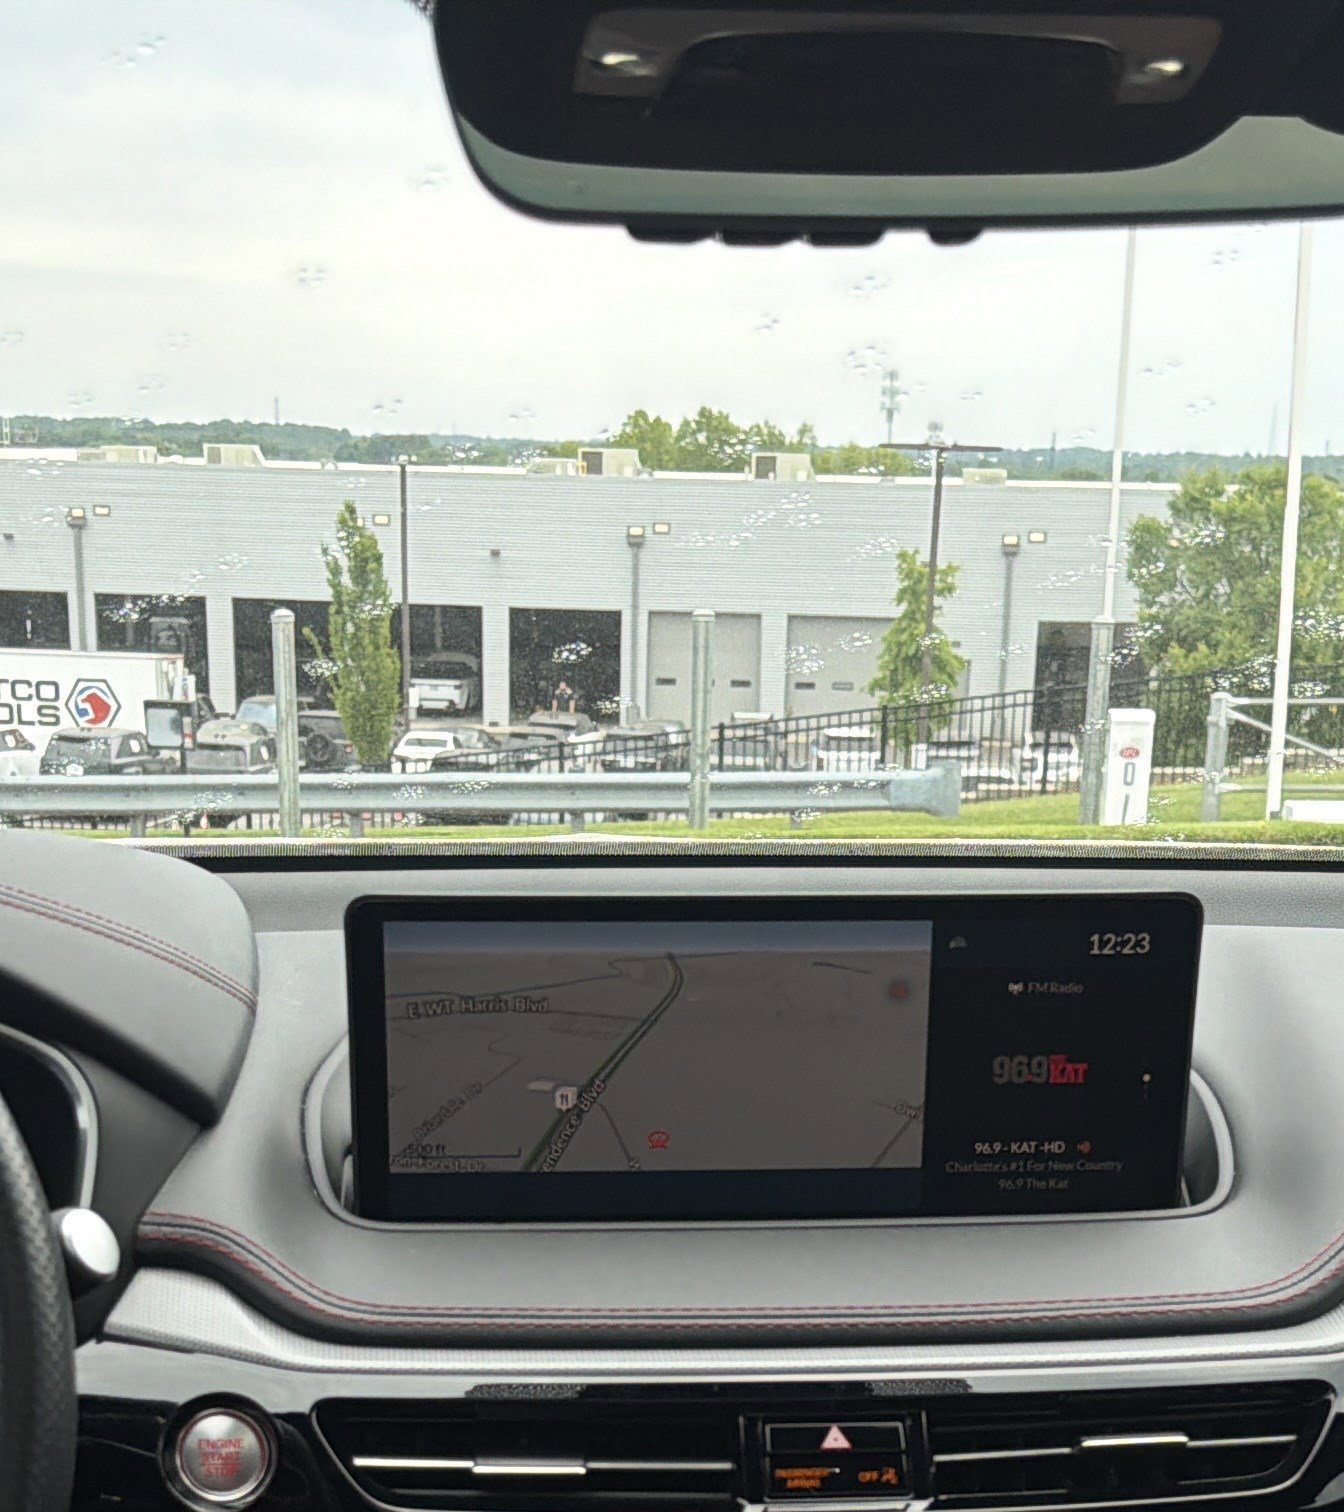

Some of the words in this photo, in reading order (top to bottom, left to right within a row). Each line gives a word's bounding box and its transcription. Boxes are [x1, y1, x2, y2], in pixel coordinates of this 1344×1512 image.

[1088, 932, 1151, 955] 12:23
[1027, 982, 1048, 994] FM
[1049, 981, 1084, 994] Radio
[408, 1003, 420, 1018] E
[461, 1000, 509, 1014] Harris
[513, 998, 549, 1012] Blvd
[576, 1079, 606, 1113] Blvd
[974, 1141, 1003, 1154] 96.9
[1010, 1141, 1038, 1154] KAT
[945, 1160, 1007, 1173] Charlotte's
[1009, 1160, 1024, 1172] #1
[1027, 1160, 1047, 1172] For
[1047, 1160, 1074, 1172] New
[1076, 1159, 1123, 1173] Country
[999, 1178, 1024, 1190] 96.9
[1026, 1178, 1047, 1189] The
[1048, 1178, 1069, 1189] Kat
[198, 1438, 243, 1449] ENGINE
